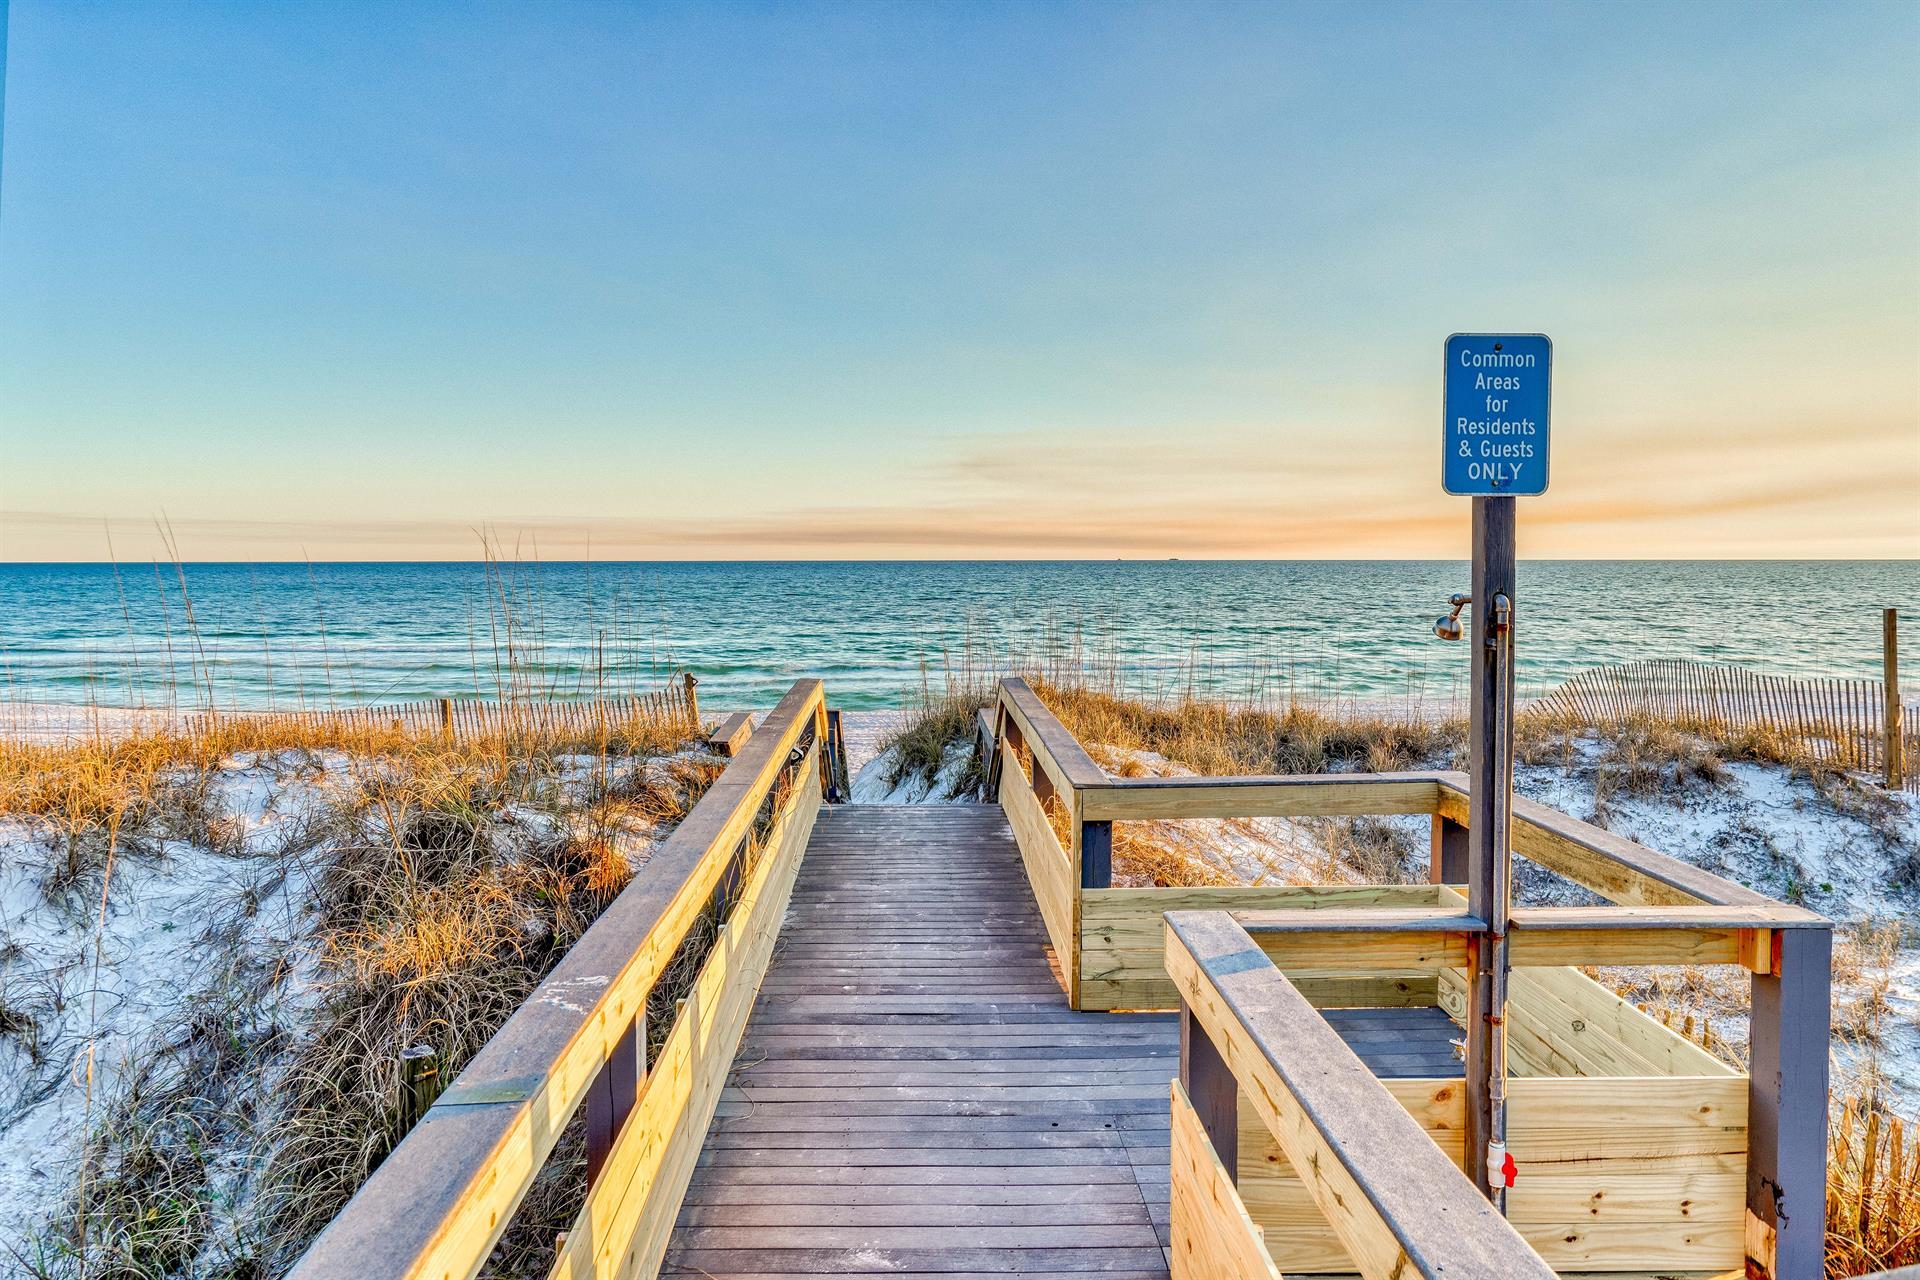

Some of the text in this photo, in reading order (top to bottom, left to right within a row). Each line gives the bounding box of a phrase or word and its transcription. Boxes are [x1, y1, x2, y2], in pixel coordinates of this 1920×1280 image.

[1461, 350, 1535, 367] Common
[1475, 373, 1520, 390] Areas
[1486, 395, 1508, 412] for
[1458, 417, 1536, 435] Residents
[1459, 440, 1534, 457] & Guests
[1468, 463, 1523, 480] ONLY
